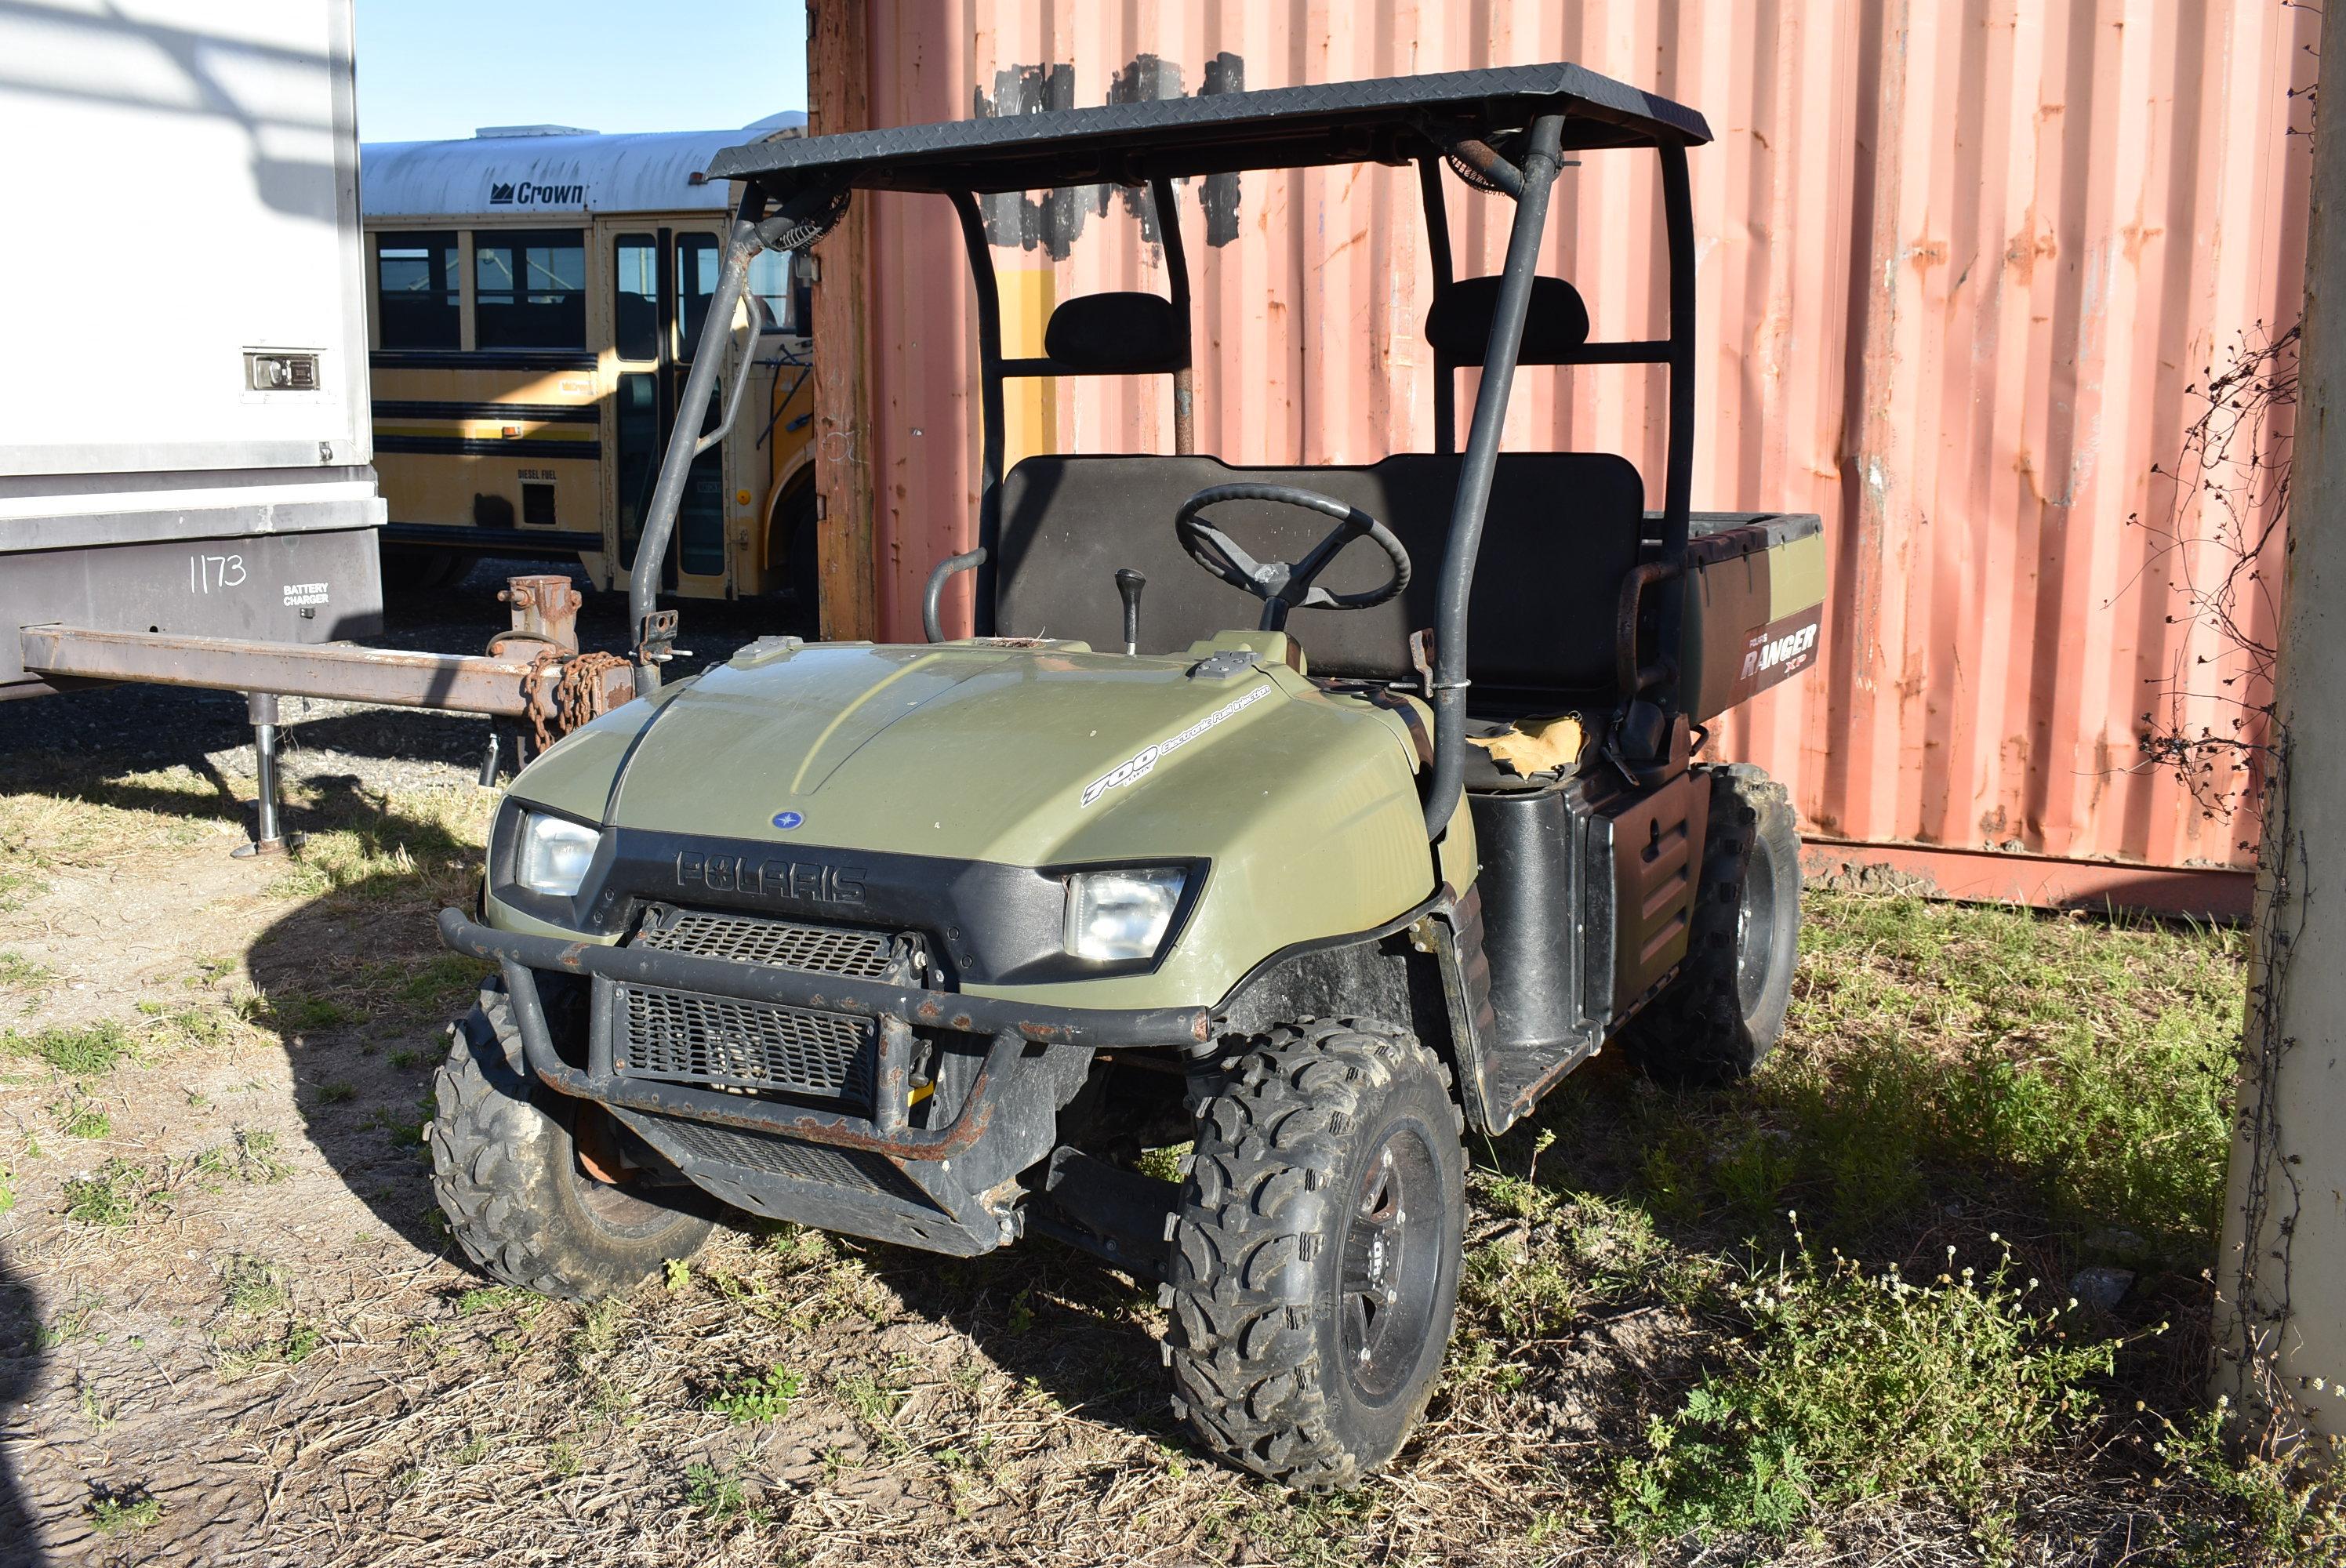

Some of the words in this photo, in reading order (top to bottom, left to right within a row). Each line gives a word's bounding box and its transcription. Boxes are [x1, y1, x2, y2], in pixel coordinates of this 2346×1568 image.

[518, 181, 583, 205] Crown
[518, 469, 539, 479] DIESEL
[541, 470, 557, 480] FUEL
[191, 554, 247, 593] 1173
[283, 583, 329, 595] BATTERY
[283, 593, 329, 606] CHARGER
[1740, 623, 1817, 681] RANGER
[1784, 654, 1807, 673] XP
[1082, 746, 1158, 807] 700
[1161, 718, 1212, 753] Electronic
[1212, 704, 1233, 724] Fuel
[1233, 685, 1270, 710] Injection
[677, 851, 868, 904] POLARIS
